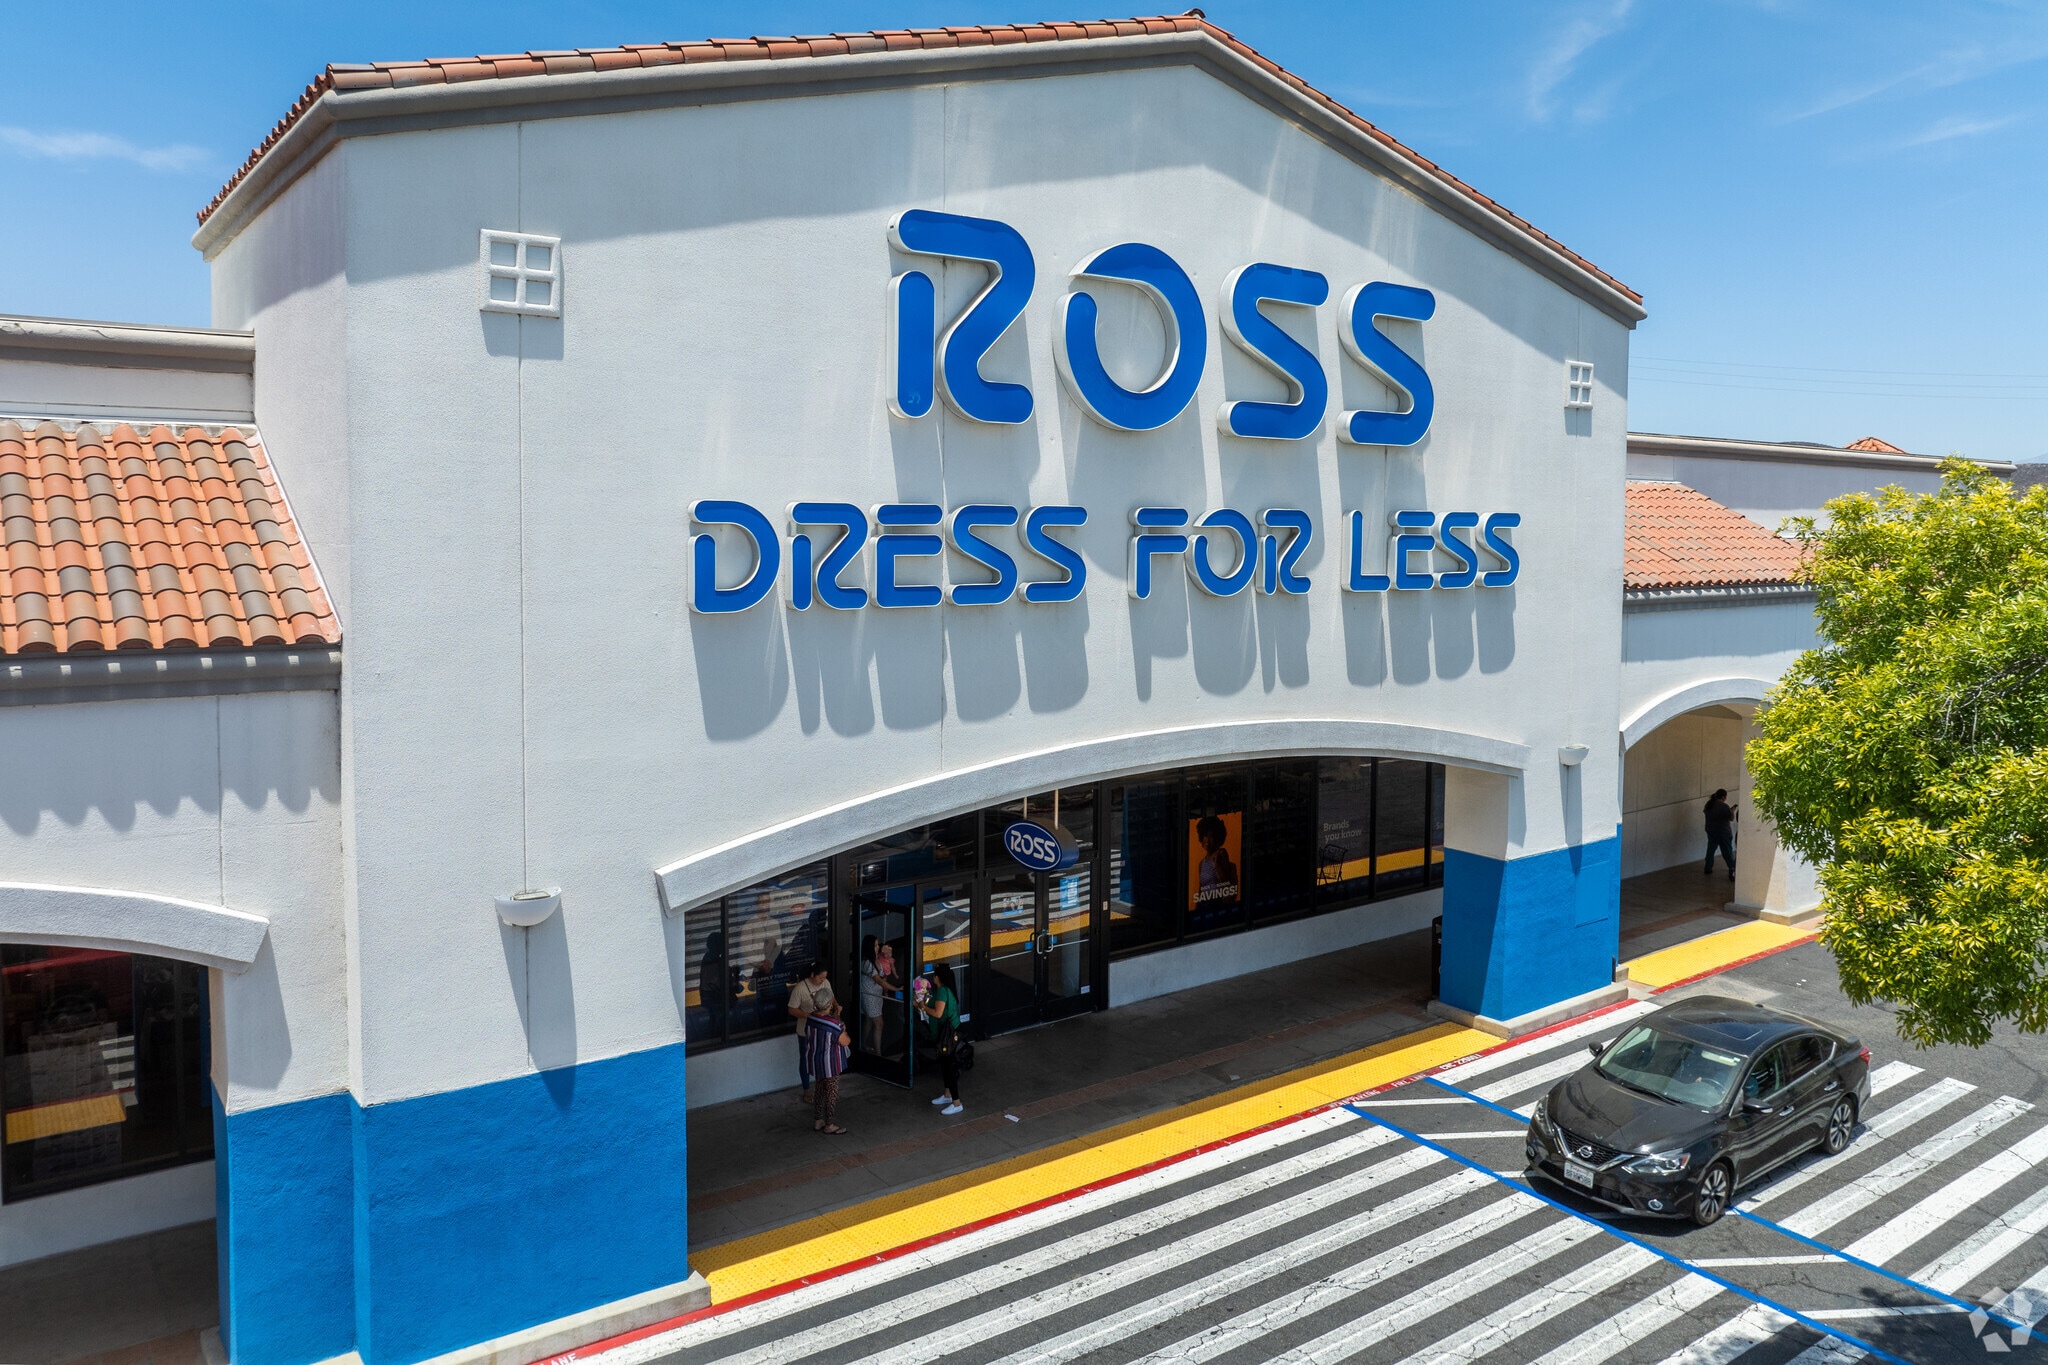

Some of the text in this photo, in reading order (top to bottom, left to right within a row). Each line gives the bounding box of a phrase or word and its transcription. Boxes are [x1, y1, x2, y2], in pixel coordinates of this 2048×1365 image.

[890, 208, 1436, 446] ROSS
[690, 499, 1521, 613] DRESS FOR LESS
[1323, 819, 1350, 832] Brands
[1324, 829, 1362, 844] you know
[1011, 829, 1055, 863] ROSS
[1193, 885, 1238, 903] SAVINGS!
